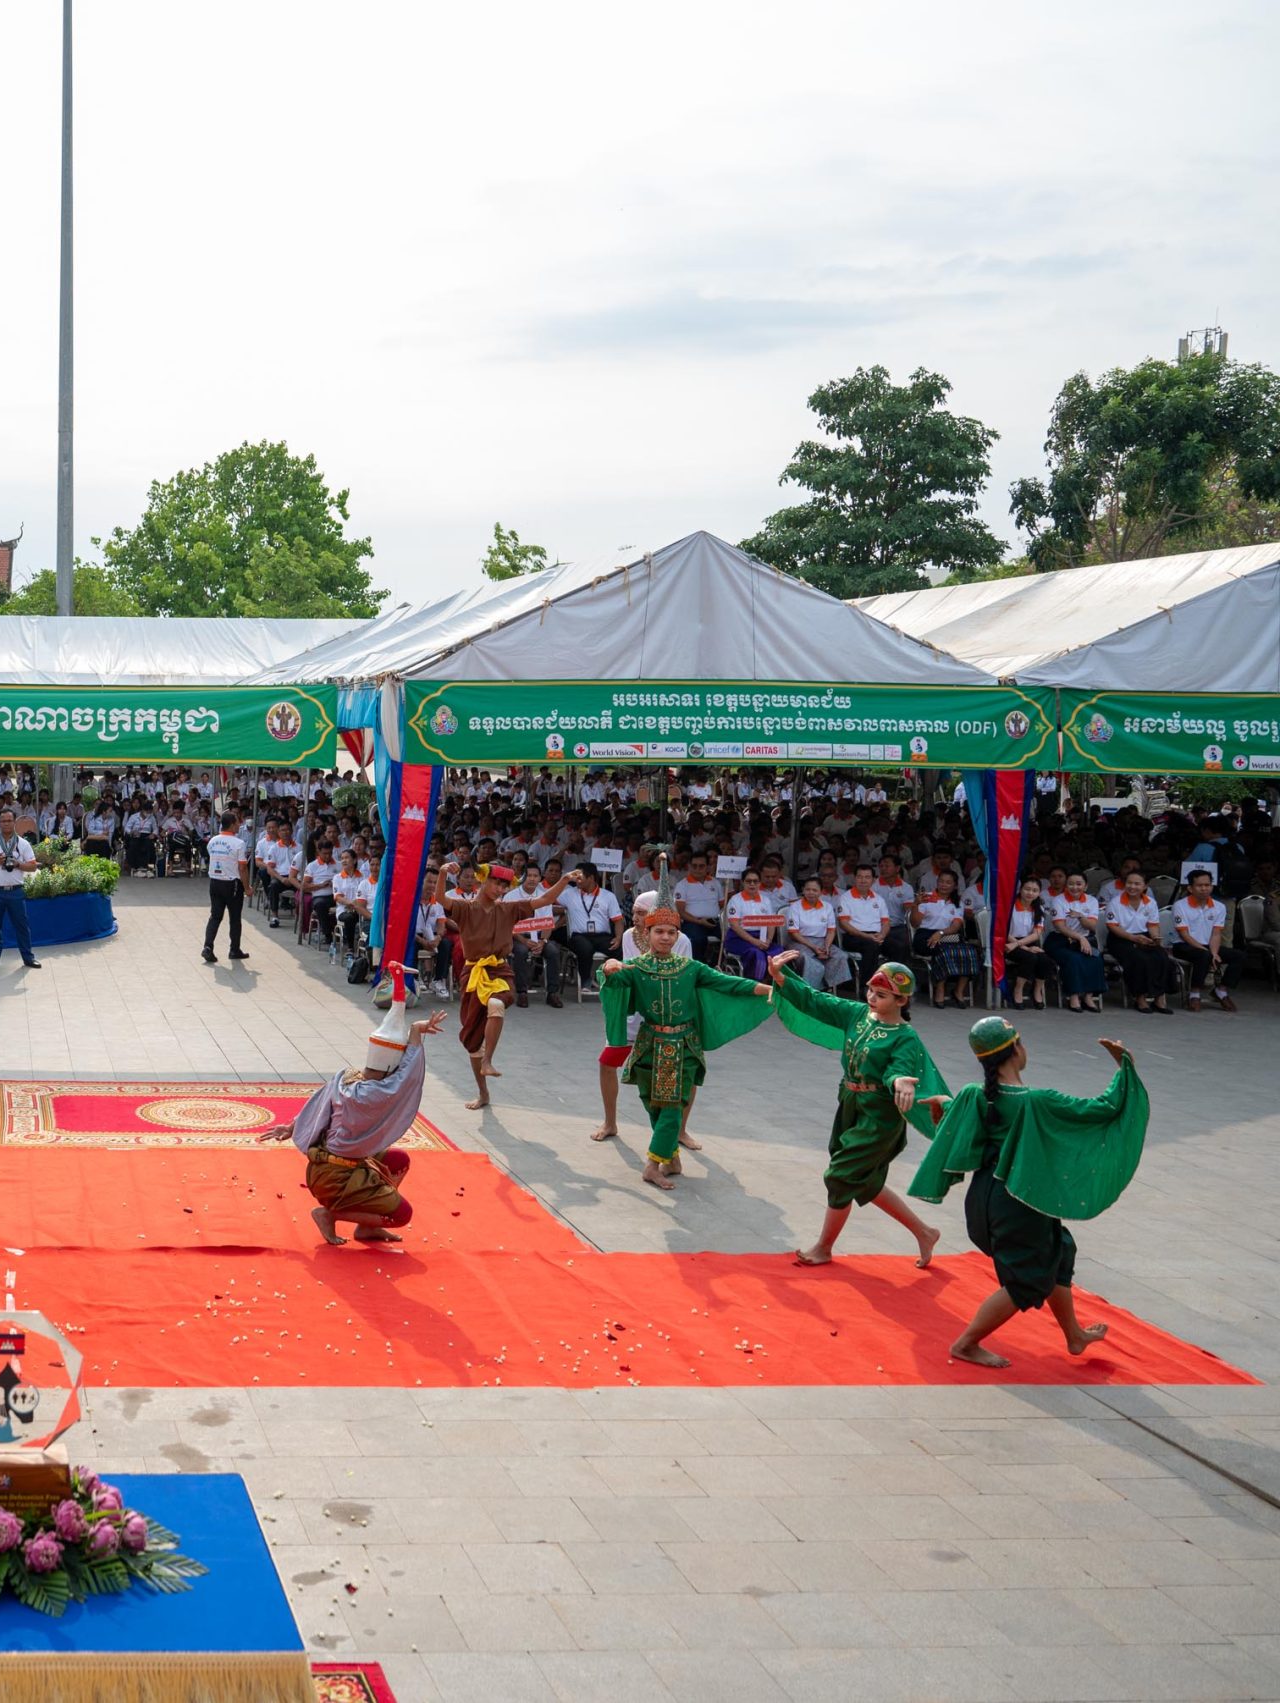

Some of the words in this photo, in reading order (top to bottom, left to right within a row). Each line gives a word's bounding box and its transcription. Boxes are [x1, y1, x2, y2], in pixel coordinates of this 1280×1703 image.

[612, 693, 700, 707] អបអរសាទរ
[706, 689, 851, 713] ខេត្តបន្ទាយមានជ័យ
[468, 709, 613, 735] ទទួលបានជ័យលាភី
[955, 720, 997, 738] (ODF)
[1124, 711, 1227, 741] អនាម័យល្អ
[1233, 719, 1280, 743] ចូលរួ
[705, 745, 730, 754] unicef
[745, 746, 778, 755] CARITAS
[1252, 761, 1274, 769] World
